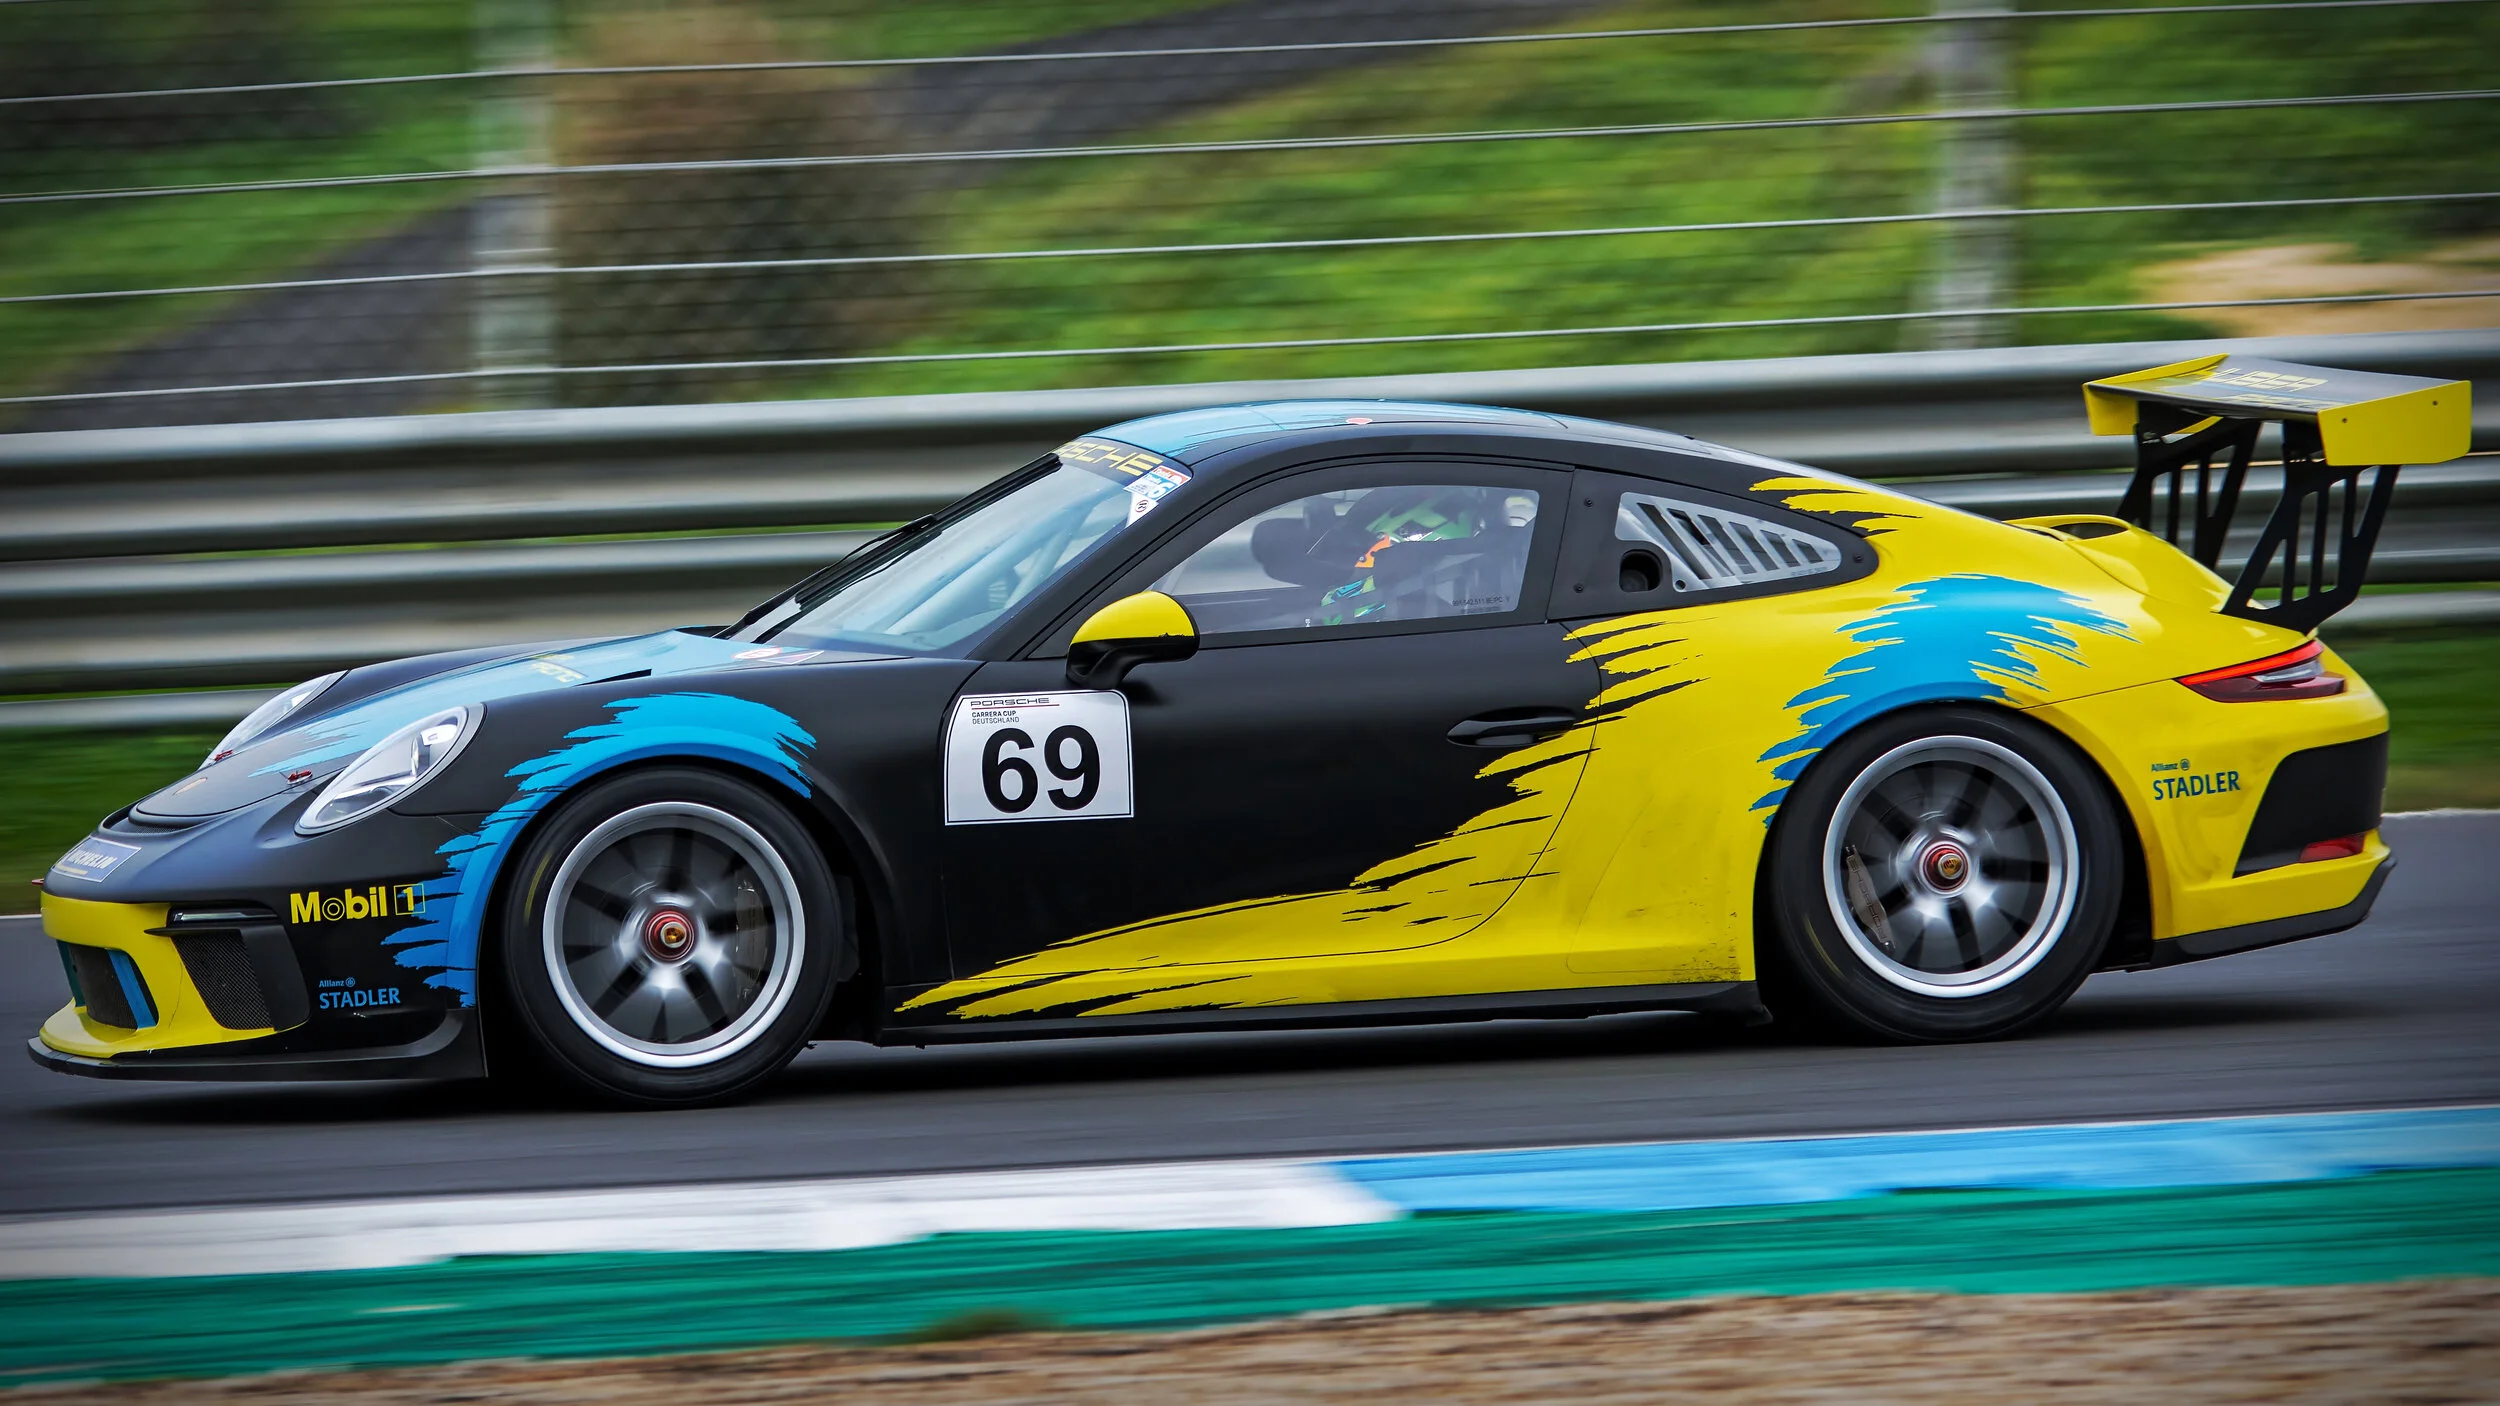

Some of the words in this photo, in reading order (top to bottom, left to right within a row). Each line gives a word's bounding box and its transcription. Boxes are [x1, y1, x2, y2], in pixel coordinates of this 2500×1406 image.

[971, 697, 1050, 707] PORSCHE
[972, 716, 1020, 725] DEUTSCHLAND
[981, 724, 1101, 814] 69
[2153, 770, 2241, 800] STADLER
[290, 886, 388, 924] Mobil
[319, 987, 401, 1009] STADLER
